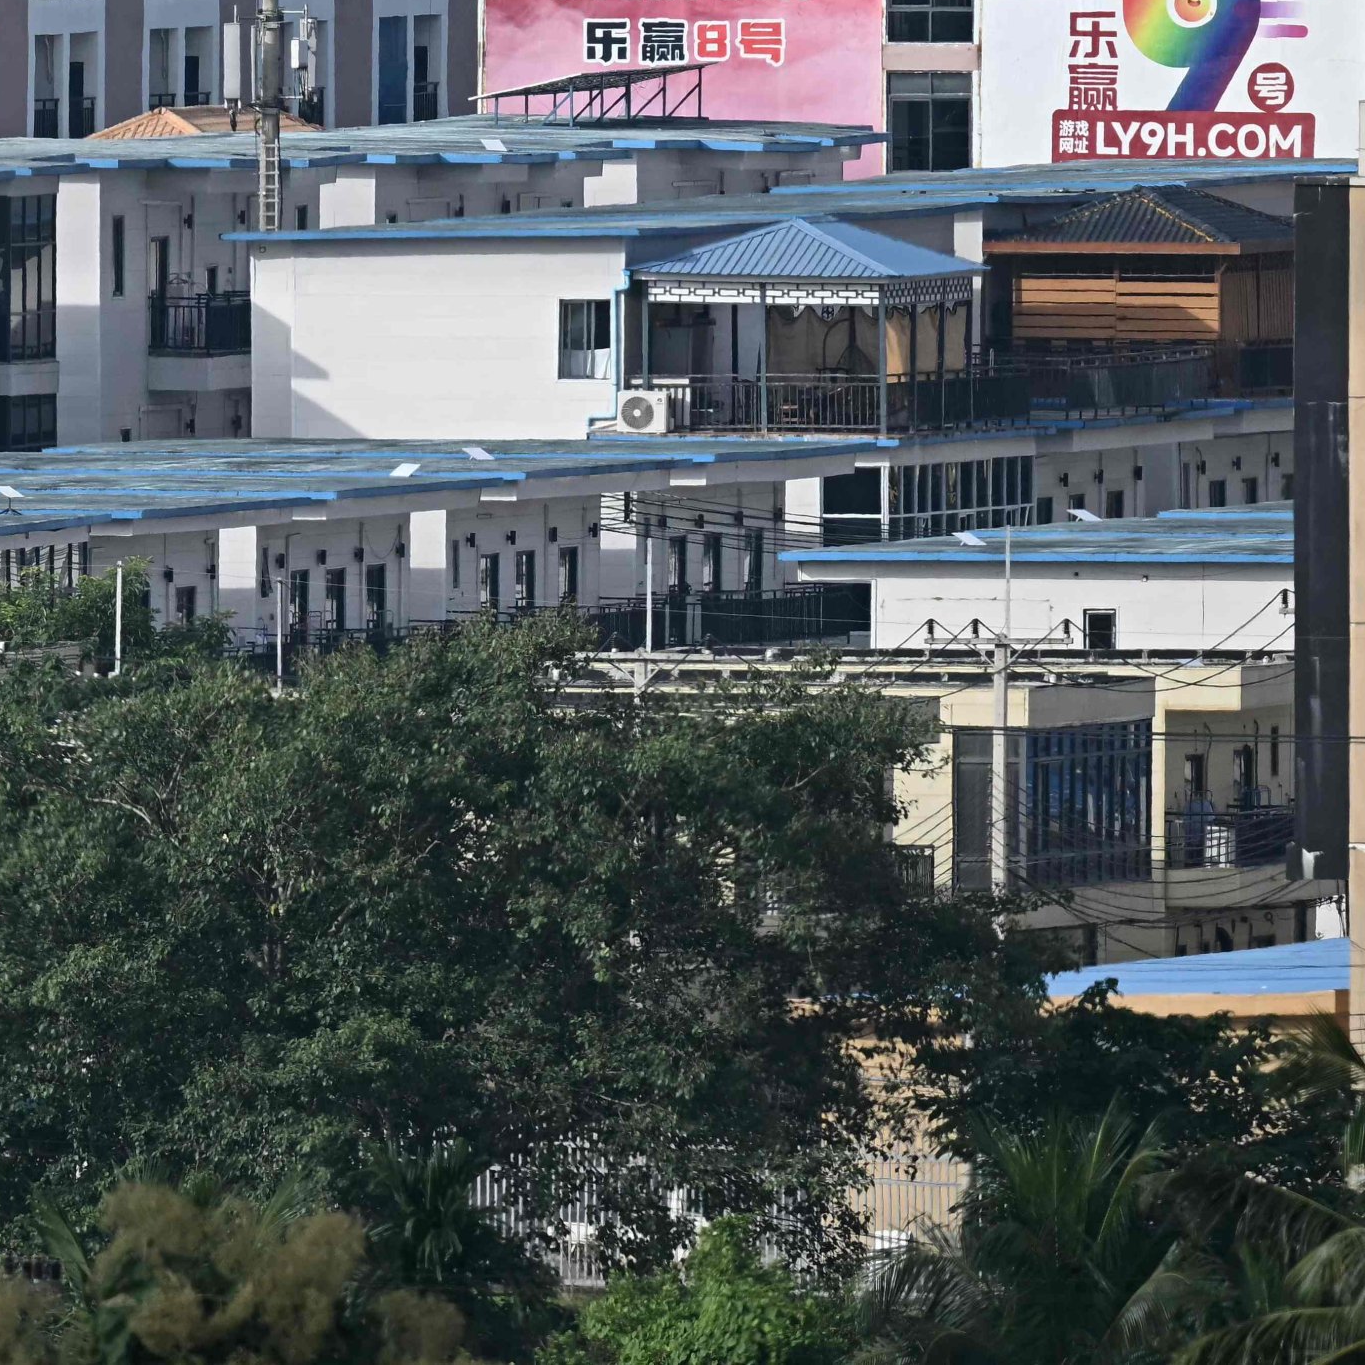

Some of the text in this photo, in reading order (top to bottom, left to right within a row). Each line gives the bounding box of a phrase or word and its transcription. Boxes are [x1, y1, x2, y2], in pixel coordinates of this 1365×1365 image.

[583, 18, 786, 67] 乐赢8号
[1068, 11, 1118, 111] 乐赢
[1253, 72, 1288, 106] 号
[1059, 120, 1089, 137] 游戏
[1059, 137, 1089, 154] 网址
[1096, 121, 1302, 158] LY9H.COM
